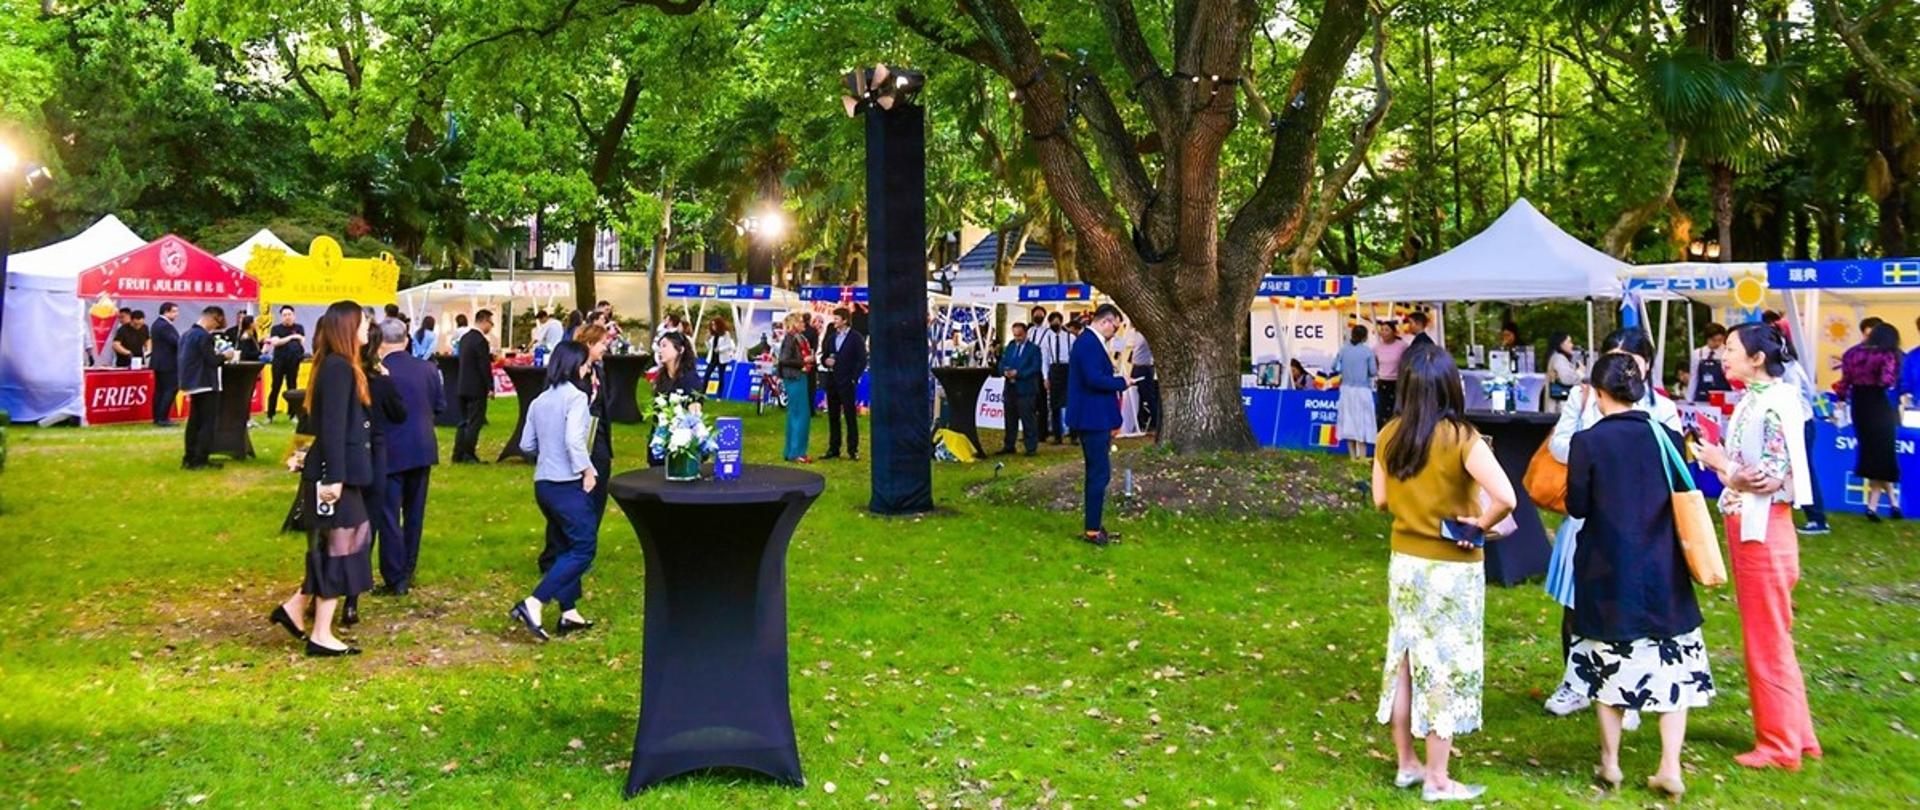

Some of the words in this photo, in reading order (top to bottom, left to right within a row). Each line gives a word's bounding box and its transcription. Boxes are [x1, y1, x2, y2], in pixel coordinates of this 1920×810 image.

[1788, 267, 1818, 282] 瑞典
[118, 277, 151, 290] FRUIT
[152, 278, 191, 292] JULIEN
[1264, 325, 1324, 339] GECE
[92, 385, 148, 408] FRIES
[985, 389, 1003, 403] Tas
[980, 403, 1004, 418] Fran
[1305, 399, 1338, 409] ROMA
[1311, 411, 1337, 421] 罗马尼
